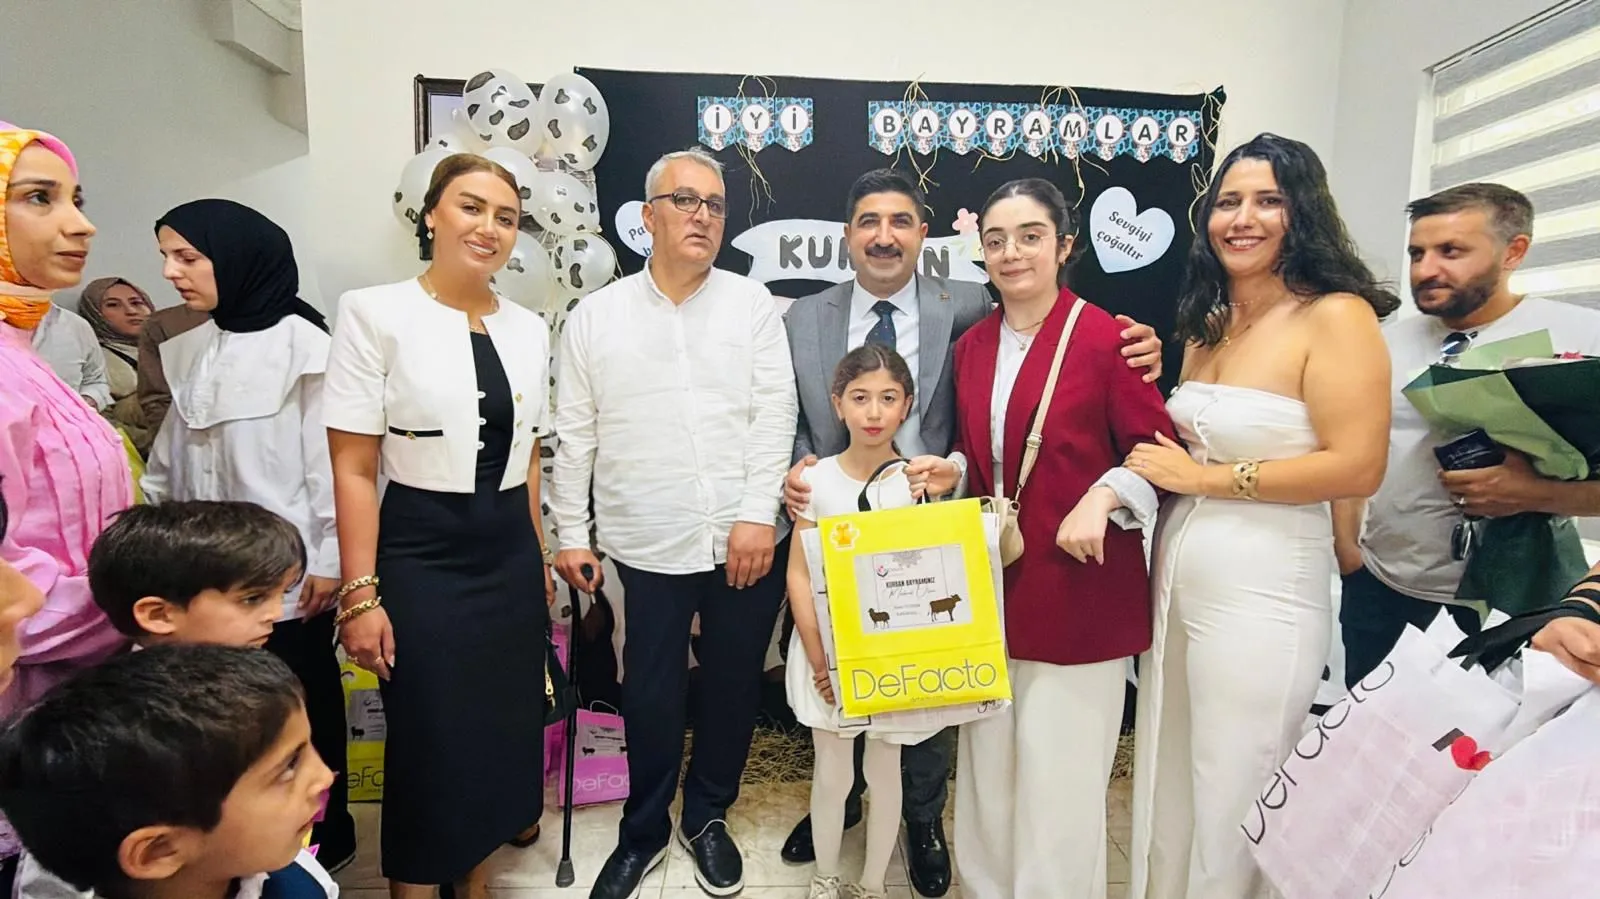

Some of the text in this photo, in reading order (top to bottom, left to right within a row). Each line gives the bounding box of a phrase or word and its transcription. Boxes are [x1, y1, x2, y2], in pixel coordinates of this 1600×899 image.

[715, 106, 1189, 143] İYİ BAYRAMLAR
[1096, 230, 1144, 260] çoğaltır
[1108, 211, 1153, 242] Sevgiyi
[779, 234, 950, 279] KUN
[851, 658, 997, 700] DeFacto
